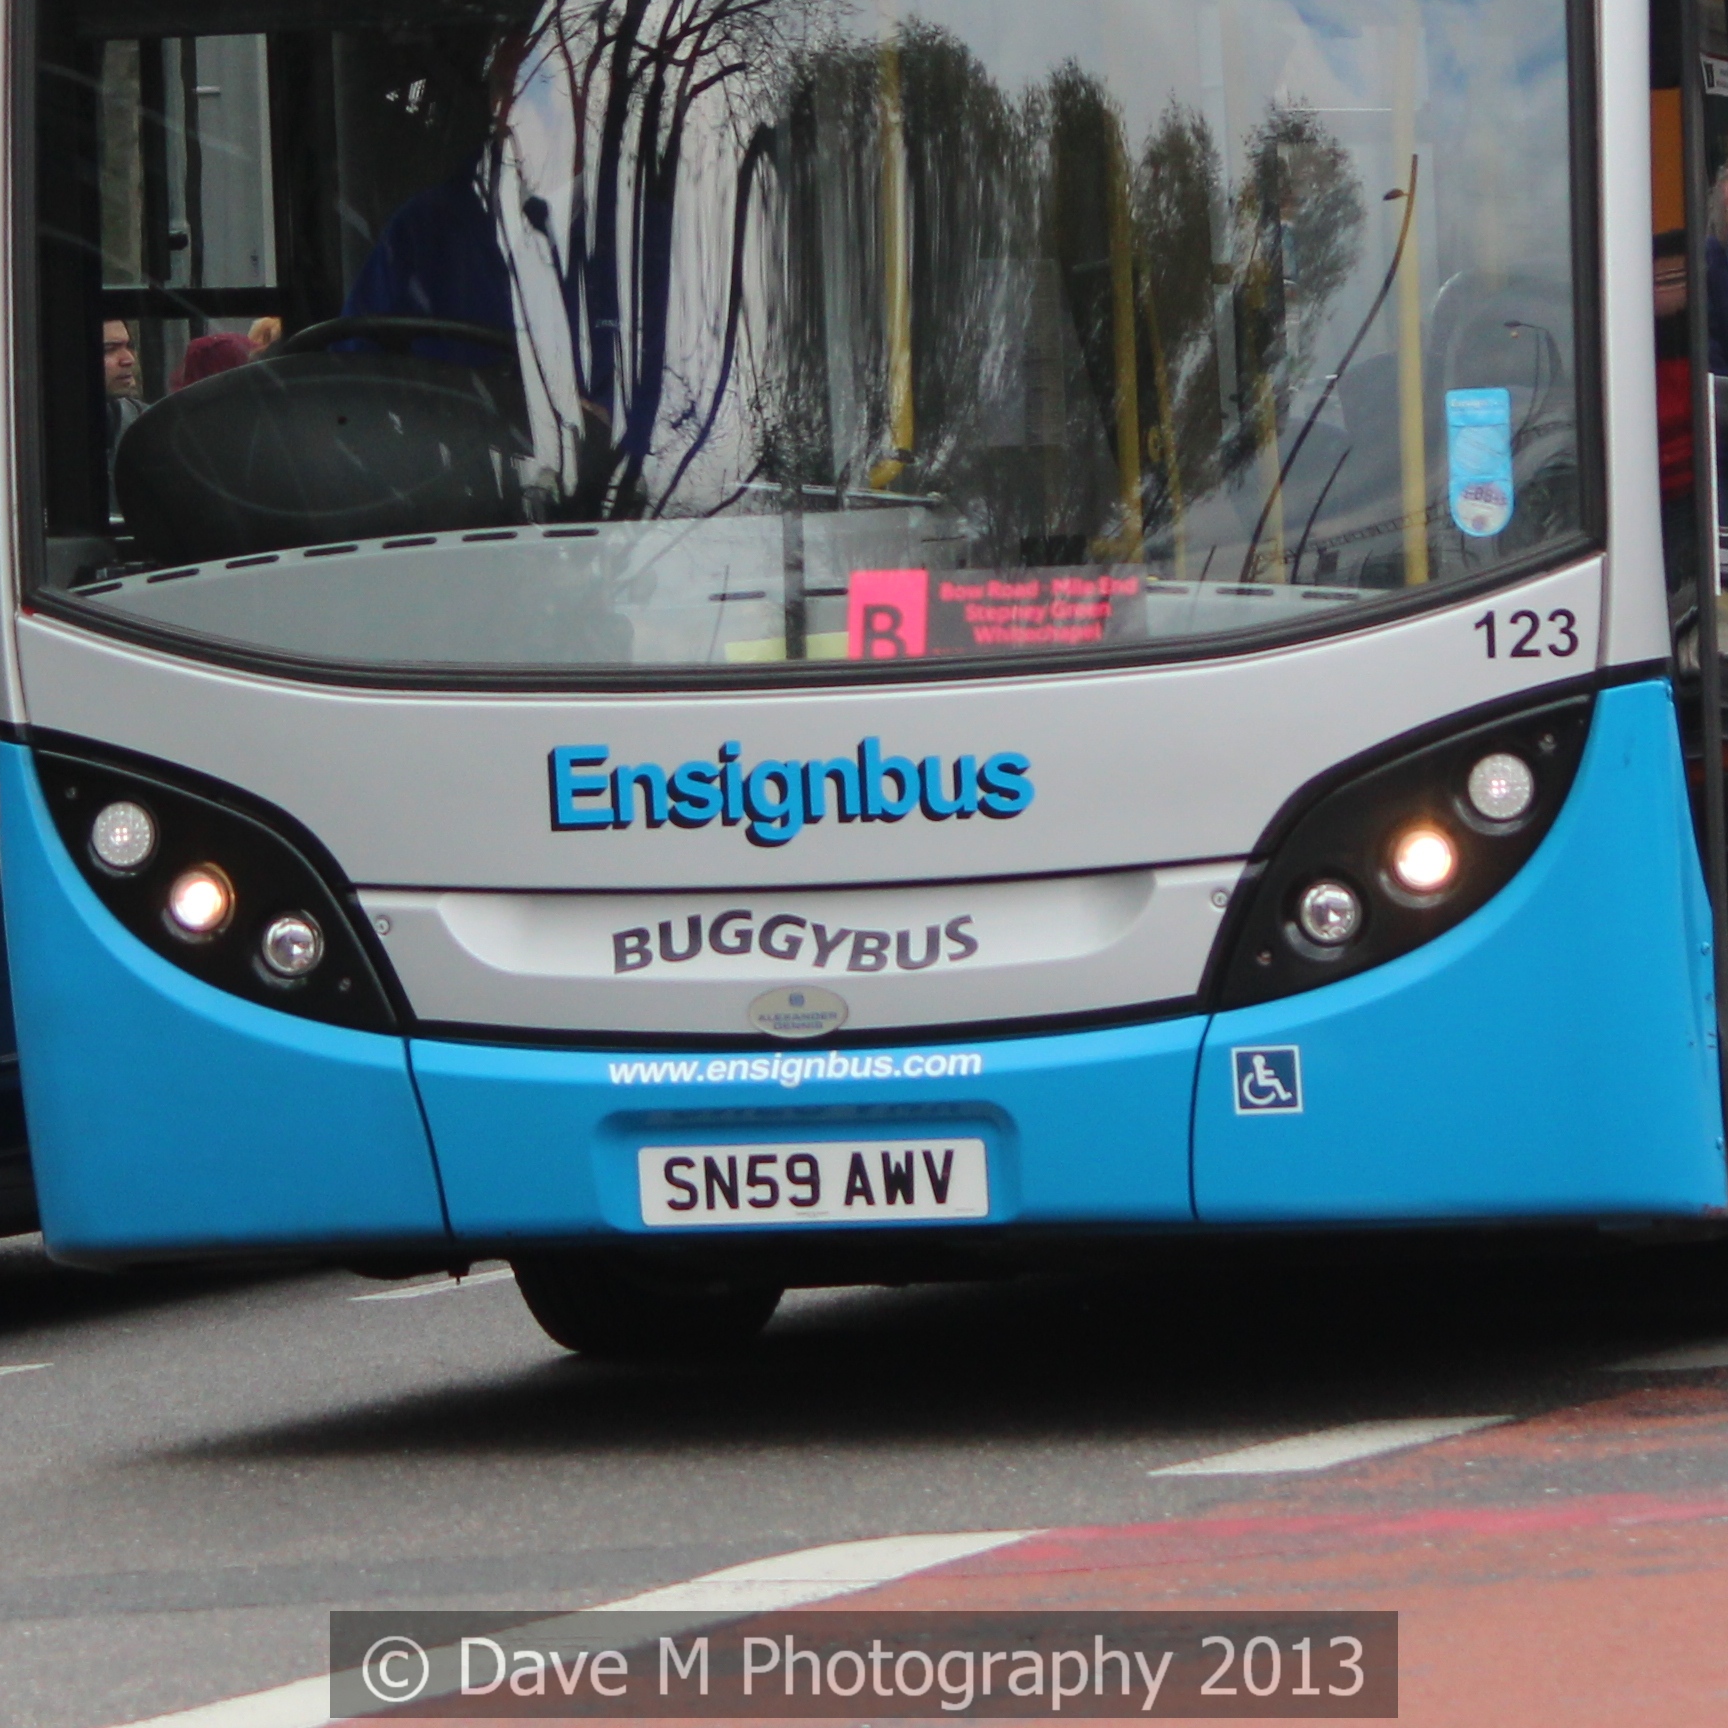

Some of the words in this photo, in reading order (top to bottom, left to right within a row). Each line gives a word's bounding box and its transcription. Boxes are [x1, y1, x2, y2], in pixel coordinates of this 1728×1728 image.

[1474, 608, 1580, 660] 123
[548, 735, 1036, 848] Ensignbus
[611, 908, 980, 975] BUGGYBUS
[608, 1050, 982, 1088] www.ensignbus.com
[663, 1152, 821, 1212] SN59
[843, 1148, 955, 1207] AWV
